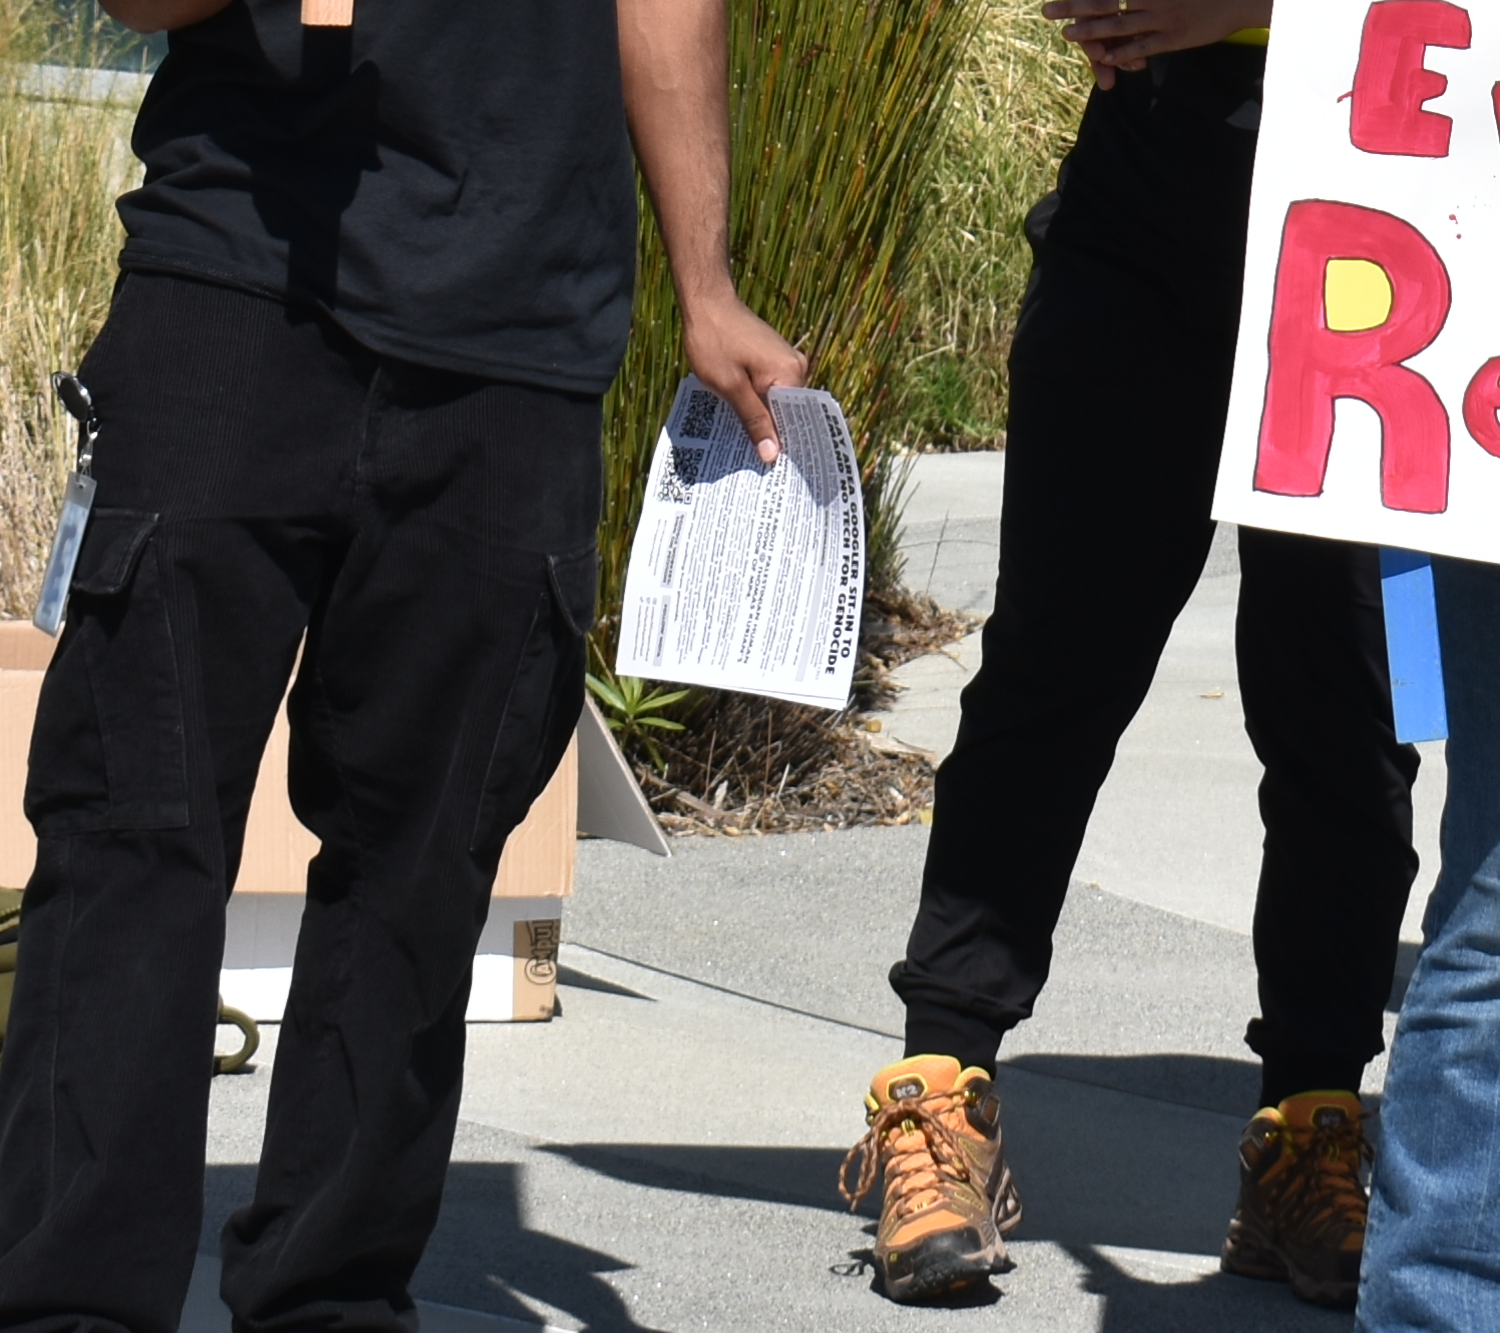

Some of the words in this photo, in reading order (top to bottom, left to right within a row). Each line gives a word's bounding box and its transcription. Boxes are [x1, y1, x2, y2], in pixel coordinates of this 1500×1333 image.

[840, 478, 851, 504] NO
[841, 454, 857, 495] AREA
[842, 510, 851, 550] TECH
[849, 501, 860, 581] GOOGLER
[840, 554, 851, 587] FOR
[845, 585, 858, 633] SIT-IN
[825, 593, 849, 675] GENOCIDE
[841, 638, 852, 660] TO
